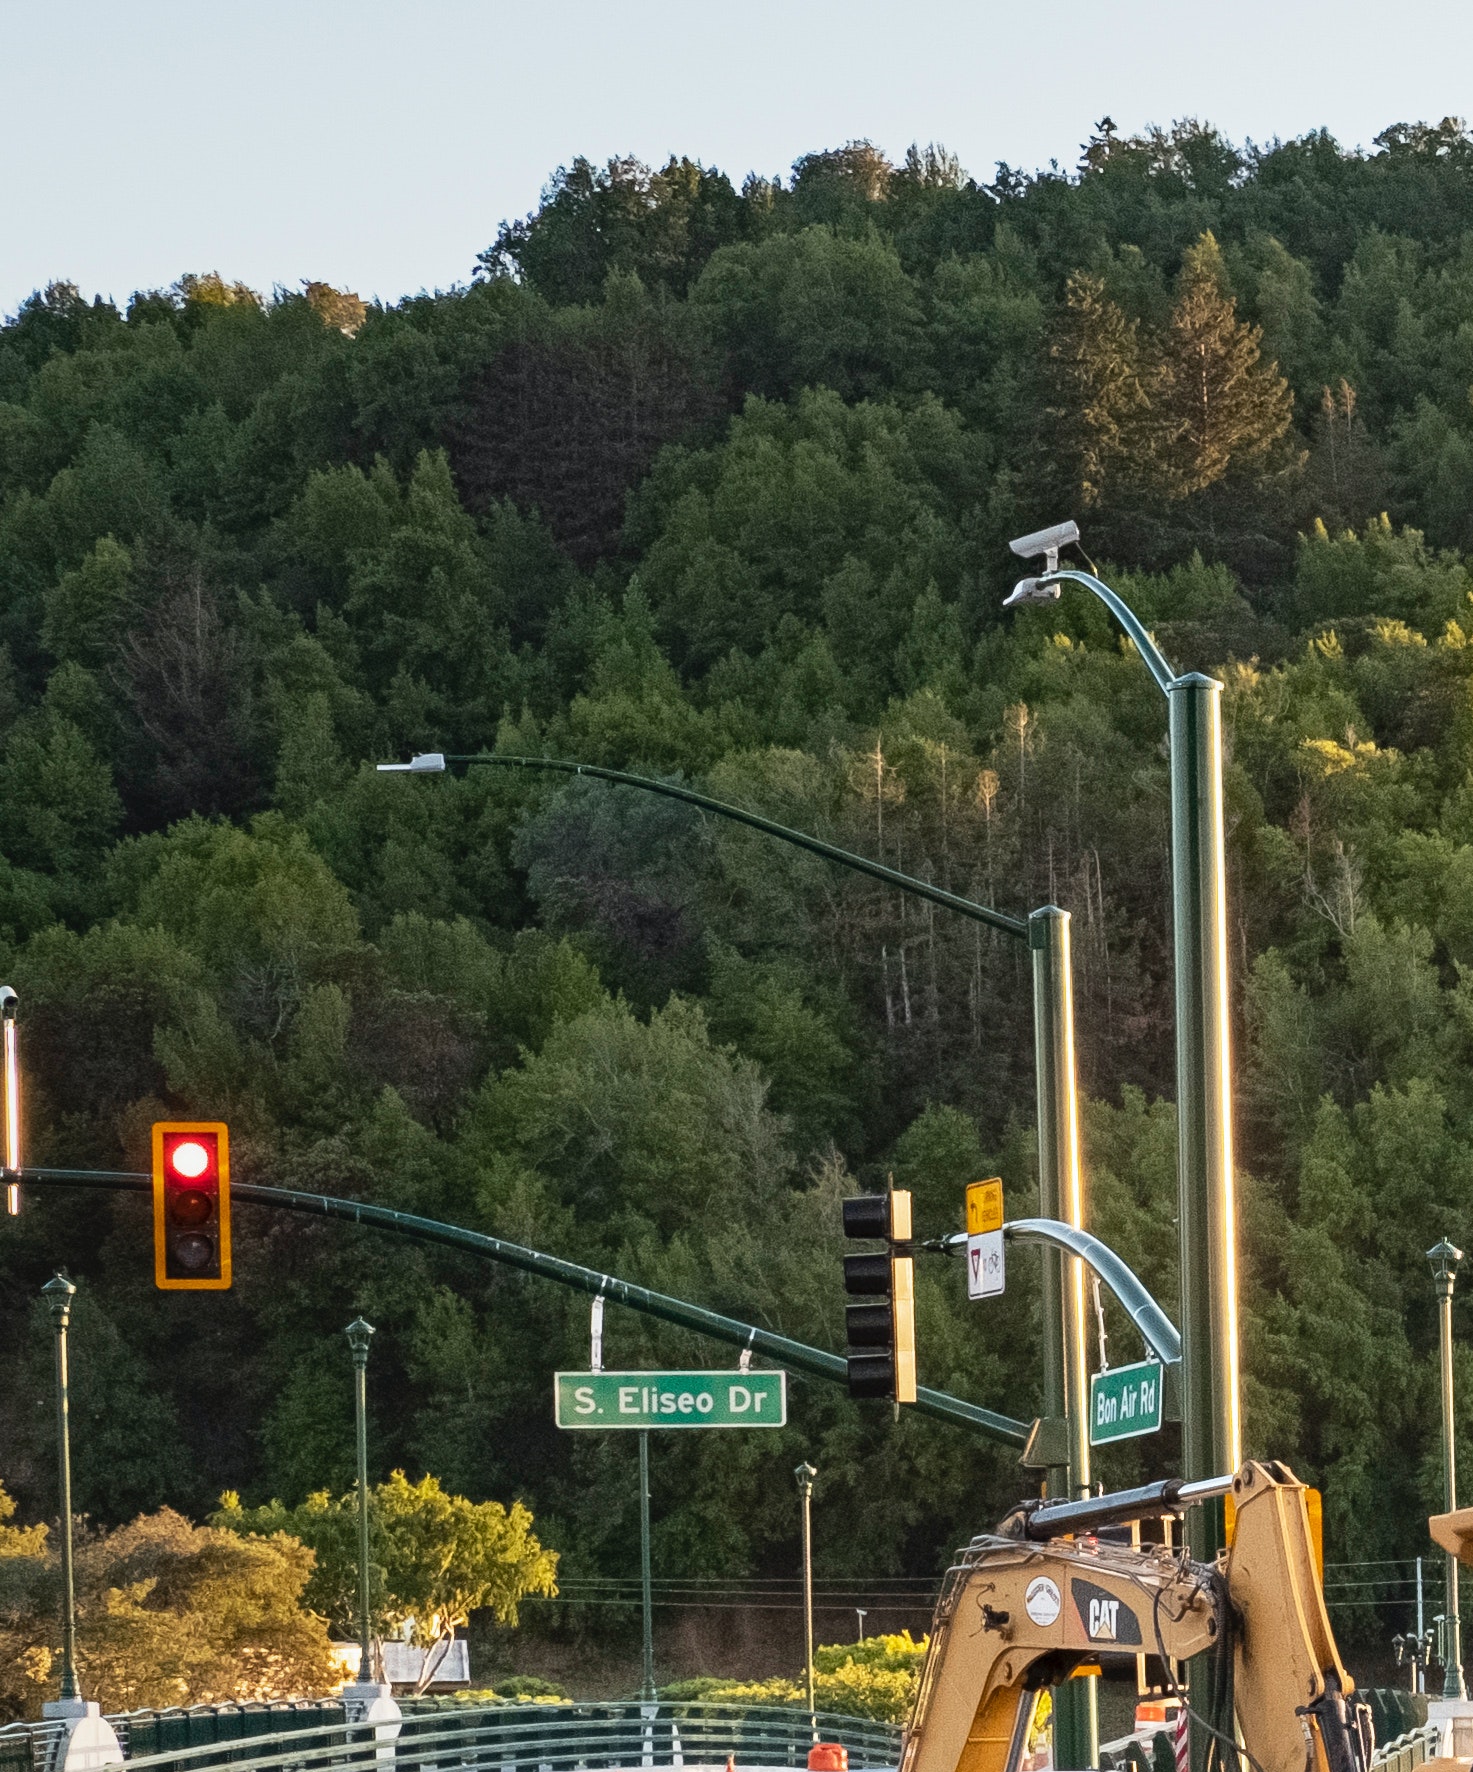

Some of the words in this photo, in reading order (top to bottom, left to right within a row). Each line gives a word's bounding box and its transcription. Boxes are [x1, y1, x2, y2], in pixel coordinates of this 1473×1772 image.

[575, 1386, 604, 1414] S.
[618, 1386, 714, 1414] Eliseo
[729, 1386, 768, 1413] Dr
[1097, 1393, 1117, 1426] Bon
[1120, 1385, 1138, 1418] Air
[1140, 1380, 1155, 1414] Rd
[1089, 1598, 1120, 1640] CAT
